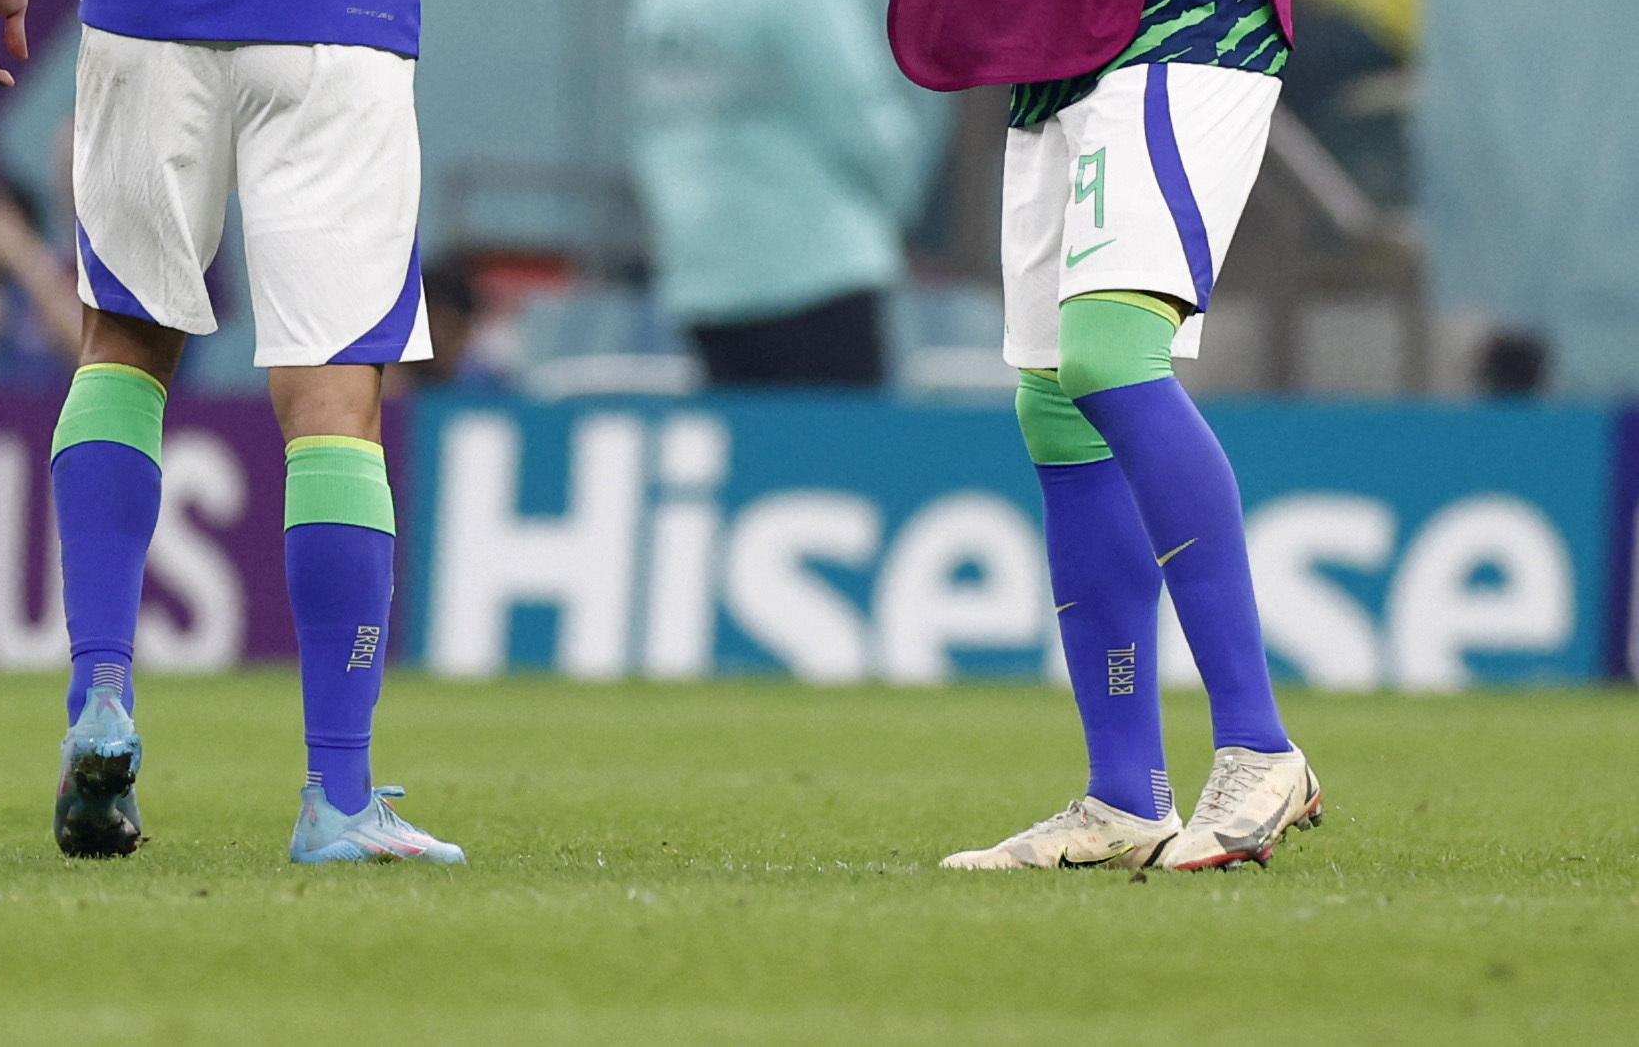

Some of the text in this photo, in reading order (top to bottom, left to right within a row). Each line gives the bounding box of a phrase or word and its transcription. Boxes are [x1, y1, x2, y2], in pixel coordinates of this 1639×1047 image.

[1074, 146, 1106, 229] 9
[428, 409, 1576, 689] Hisese
[346, 625, 380, 672] BRASIL
[1107, 642, 1135, 696] BRASIL
